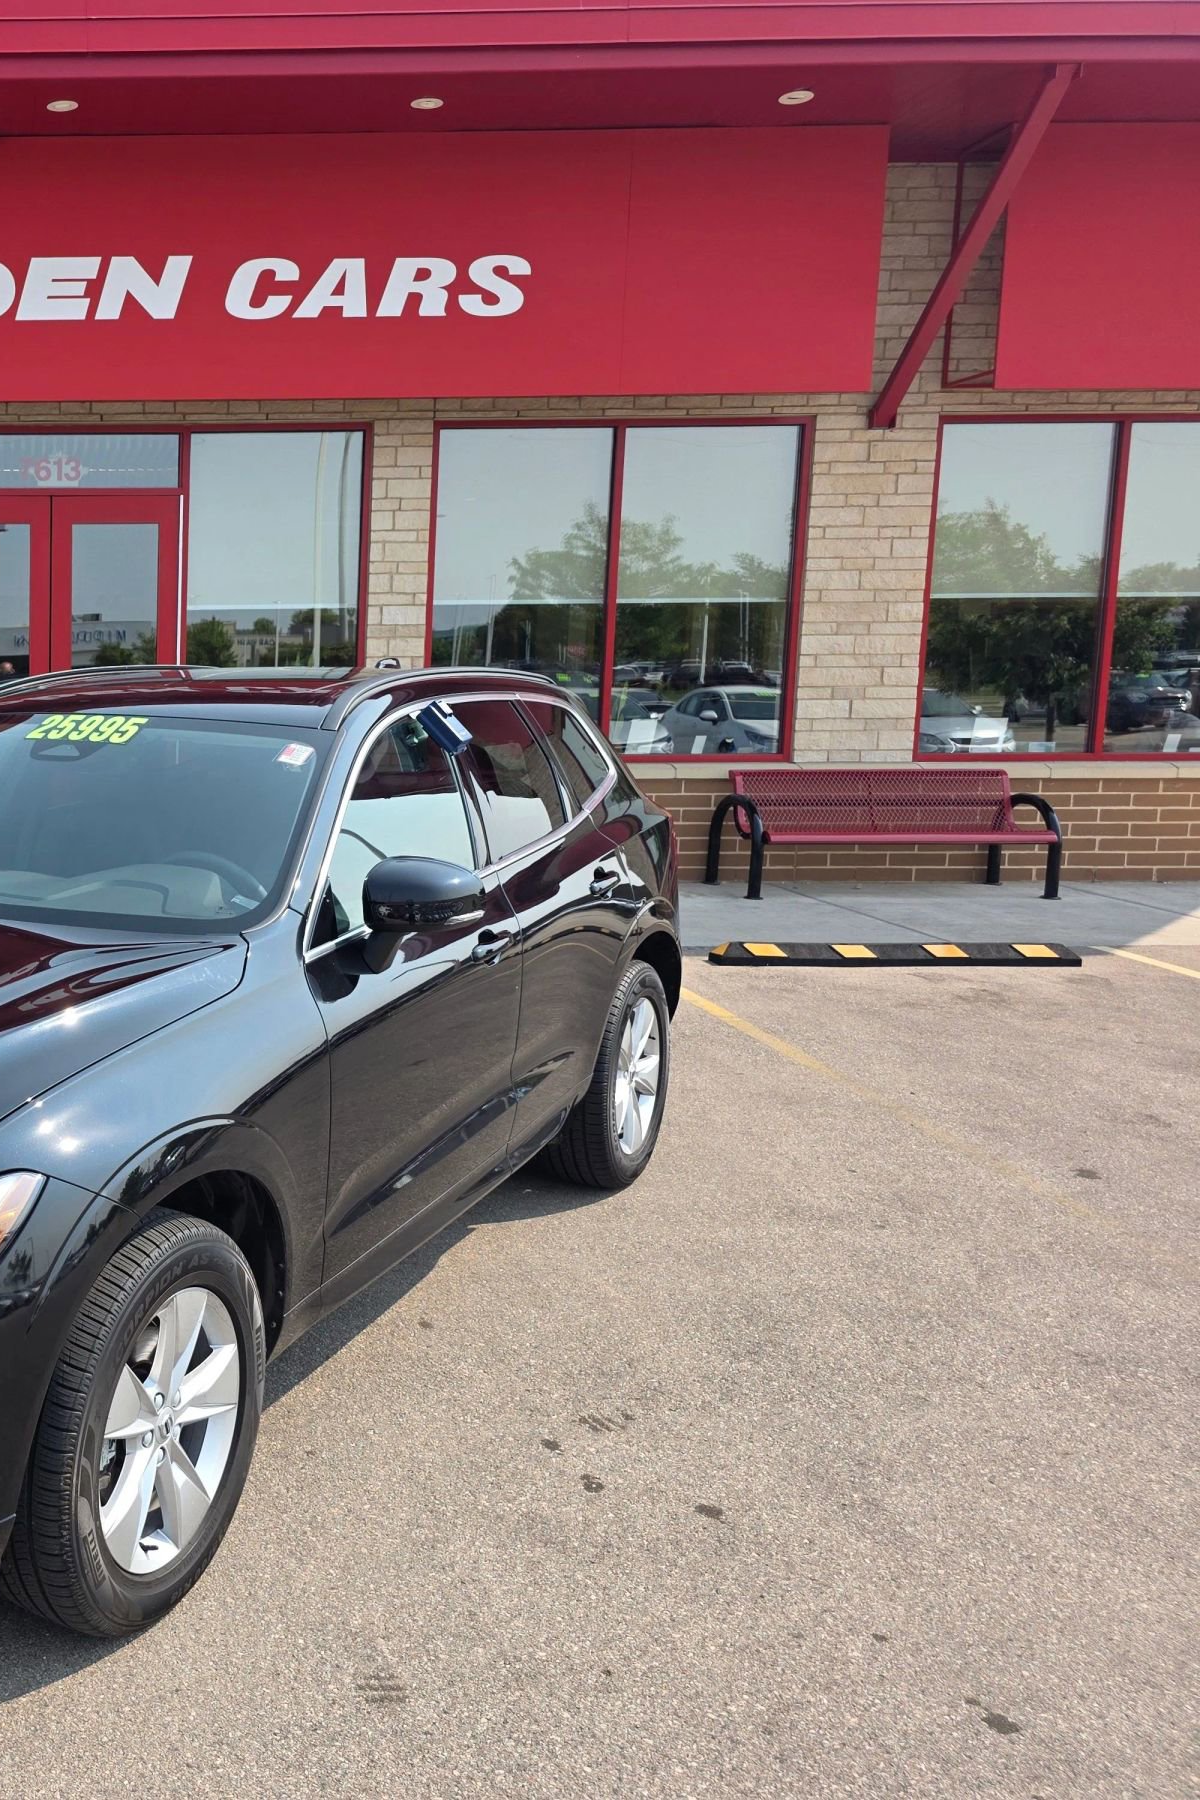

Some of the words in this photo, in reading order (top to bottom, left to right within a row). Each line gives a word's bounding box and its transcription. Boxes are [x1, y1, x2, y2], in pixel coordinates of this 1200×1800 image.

[225, 255, 531, 319] CARS
[19, 456, 81, 481] 7613
[24, 714, 149, 744] 25995
